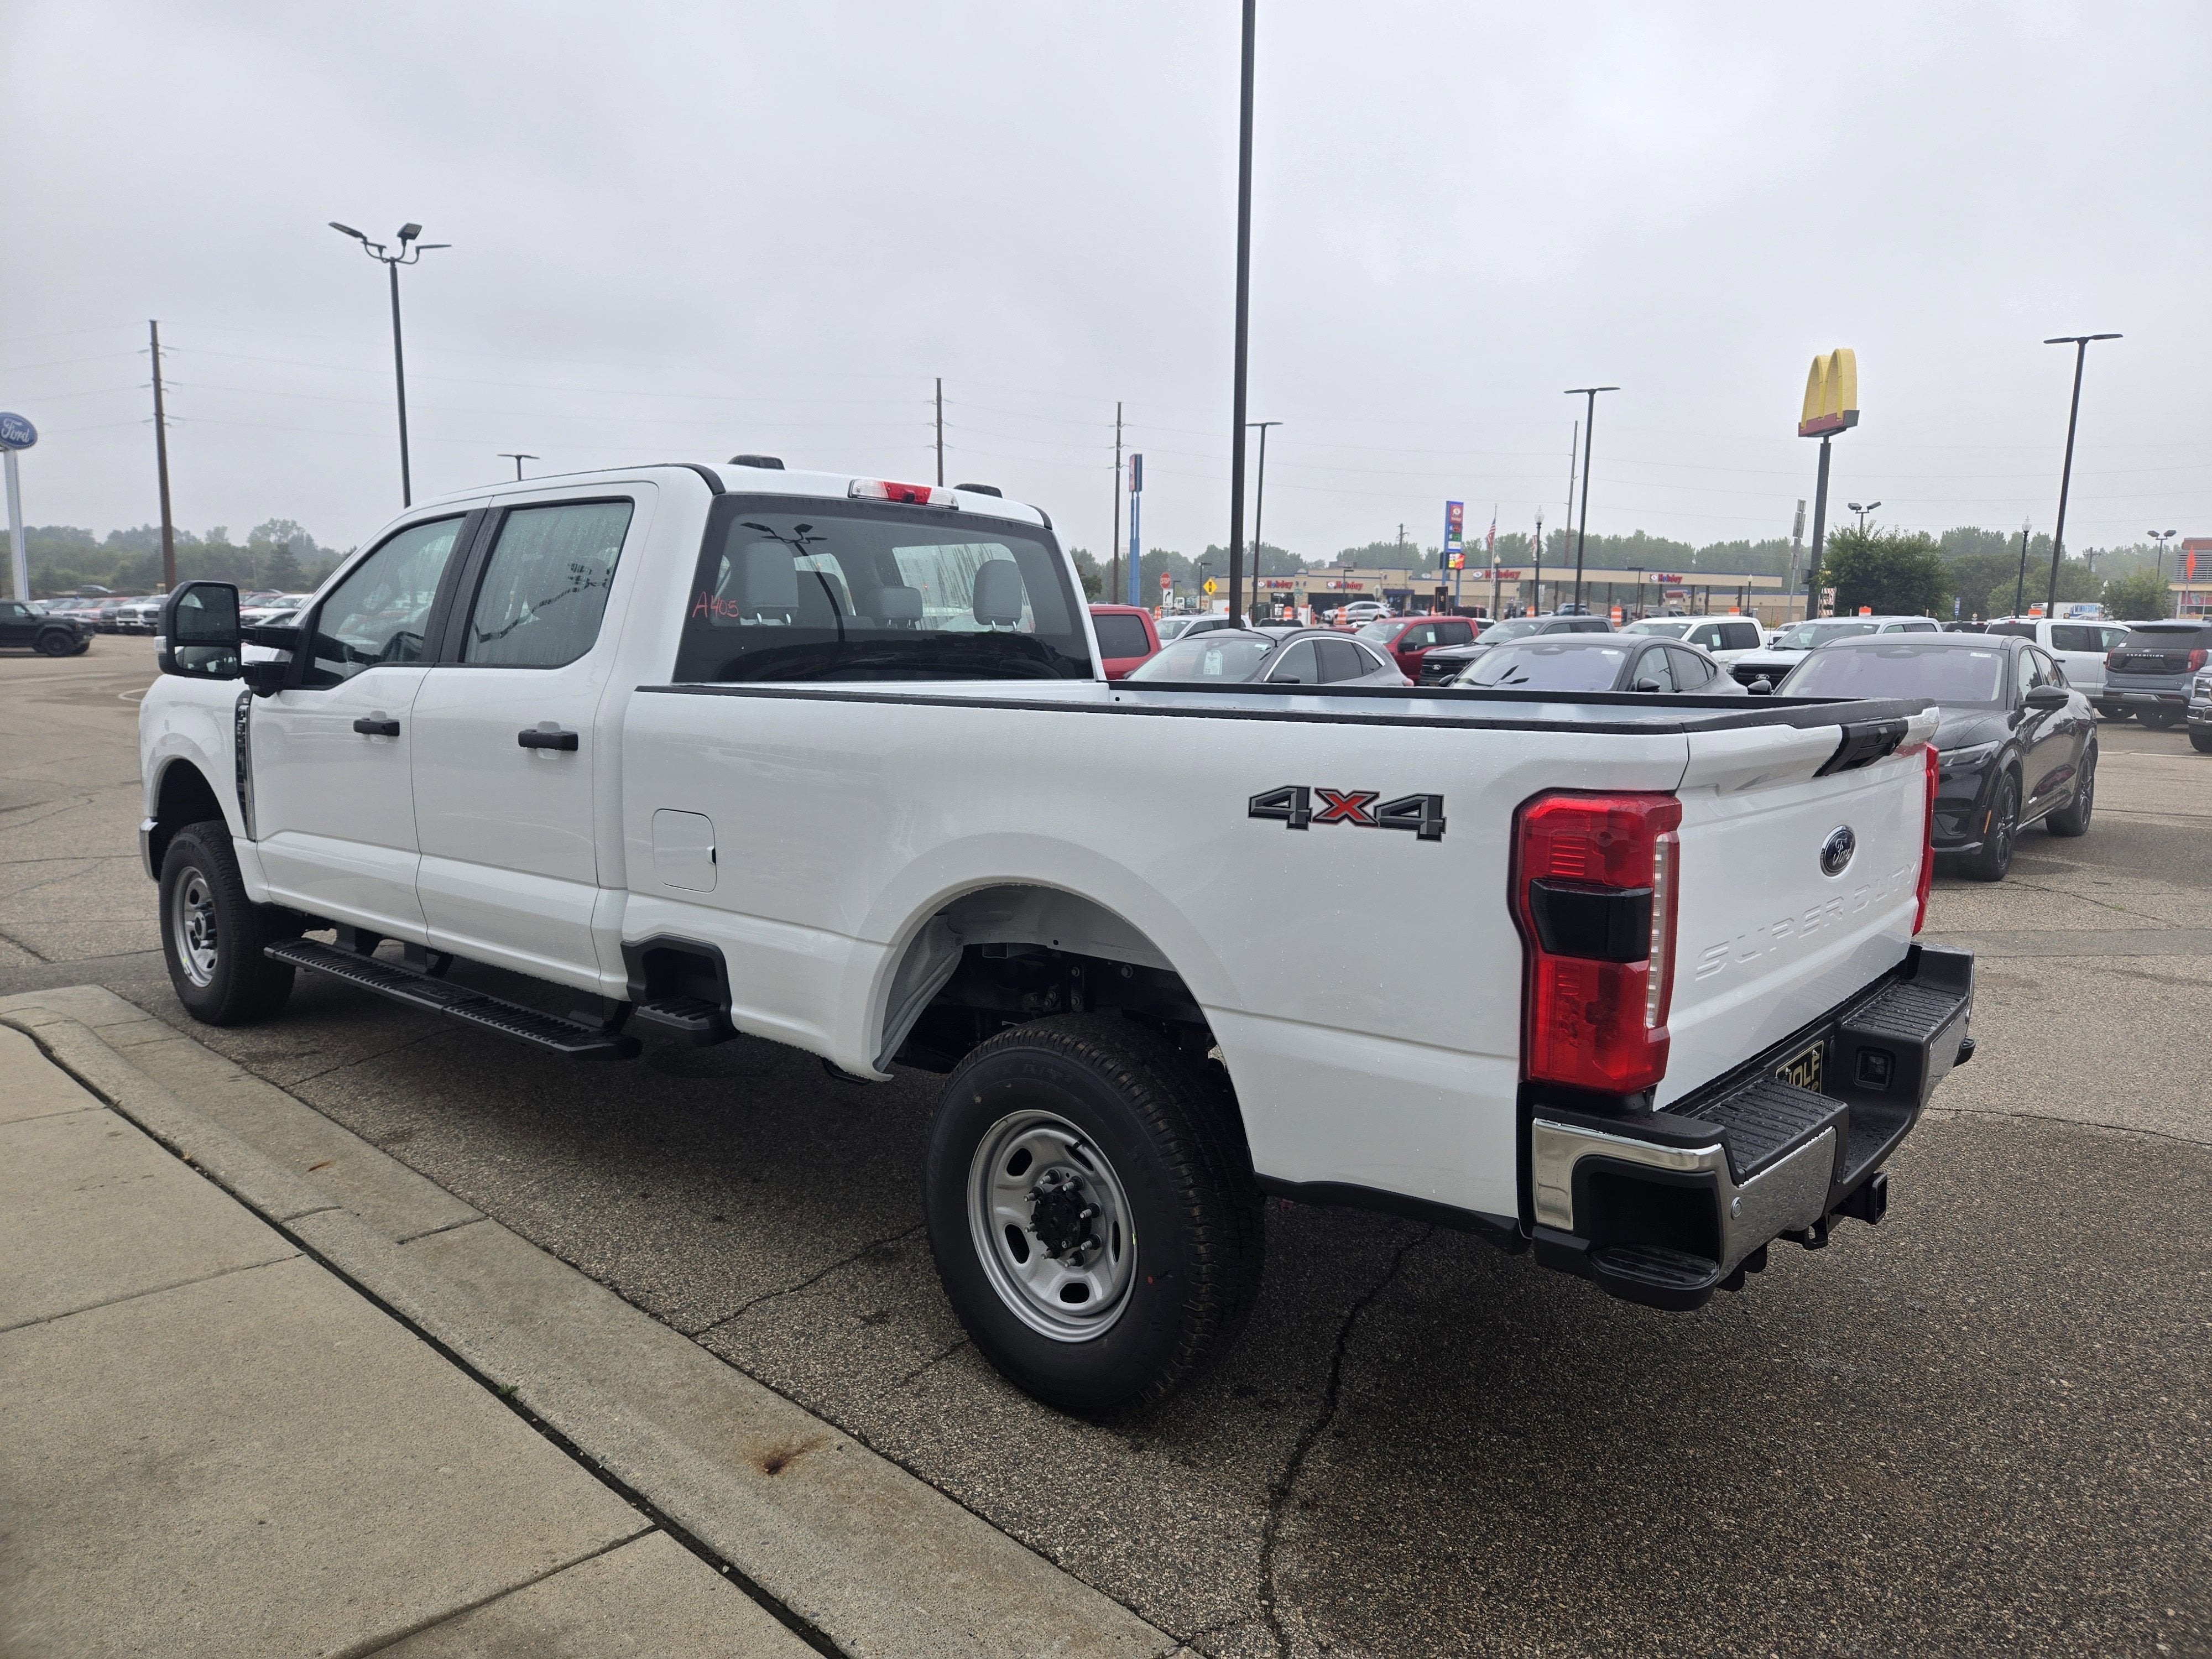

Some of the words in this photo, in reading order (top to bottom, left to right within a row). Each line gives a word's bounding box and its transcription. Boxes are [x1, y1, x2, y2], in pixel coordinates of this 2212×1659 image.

[1, 418, 30, 443] Ford
[1266, 580, 1293, 589] Holiday
[1658, 573, 1682, 584] Holiday
[692, 591, 739, 618] A405
[1833, 836, 1853, 867] Ford
[1695, 896, 1844, 982] SUPER
[1853, 859, 1917, 914] DUTY
